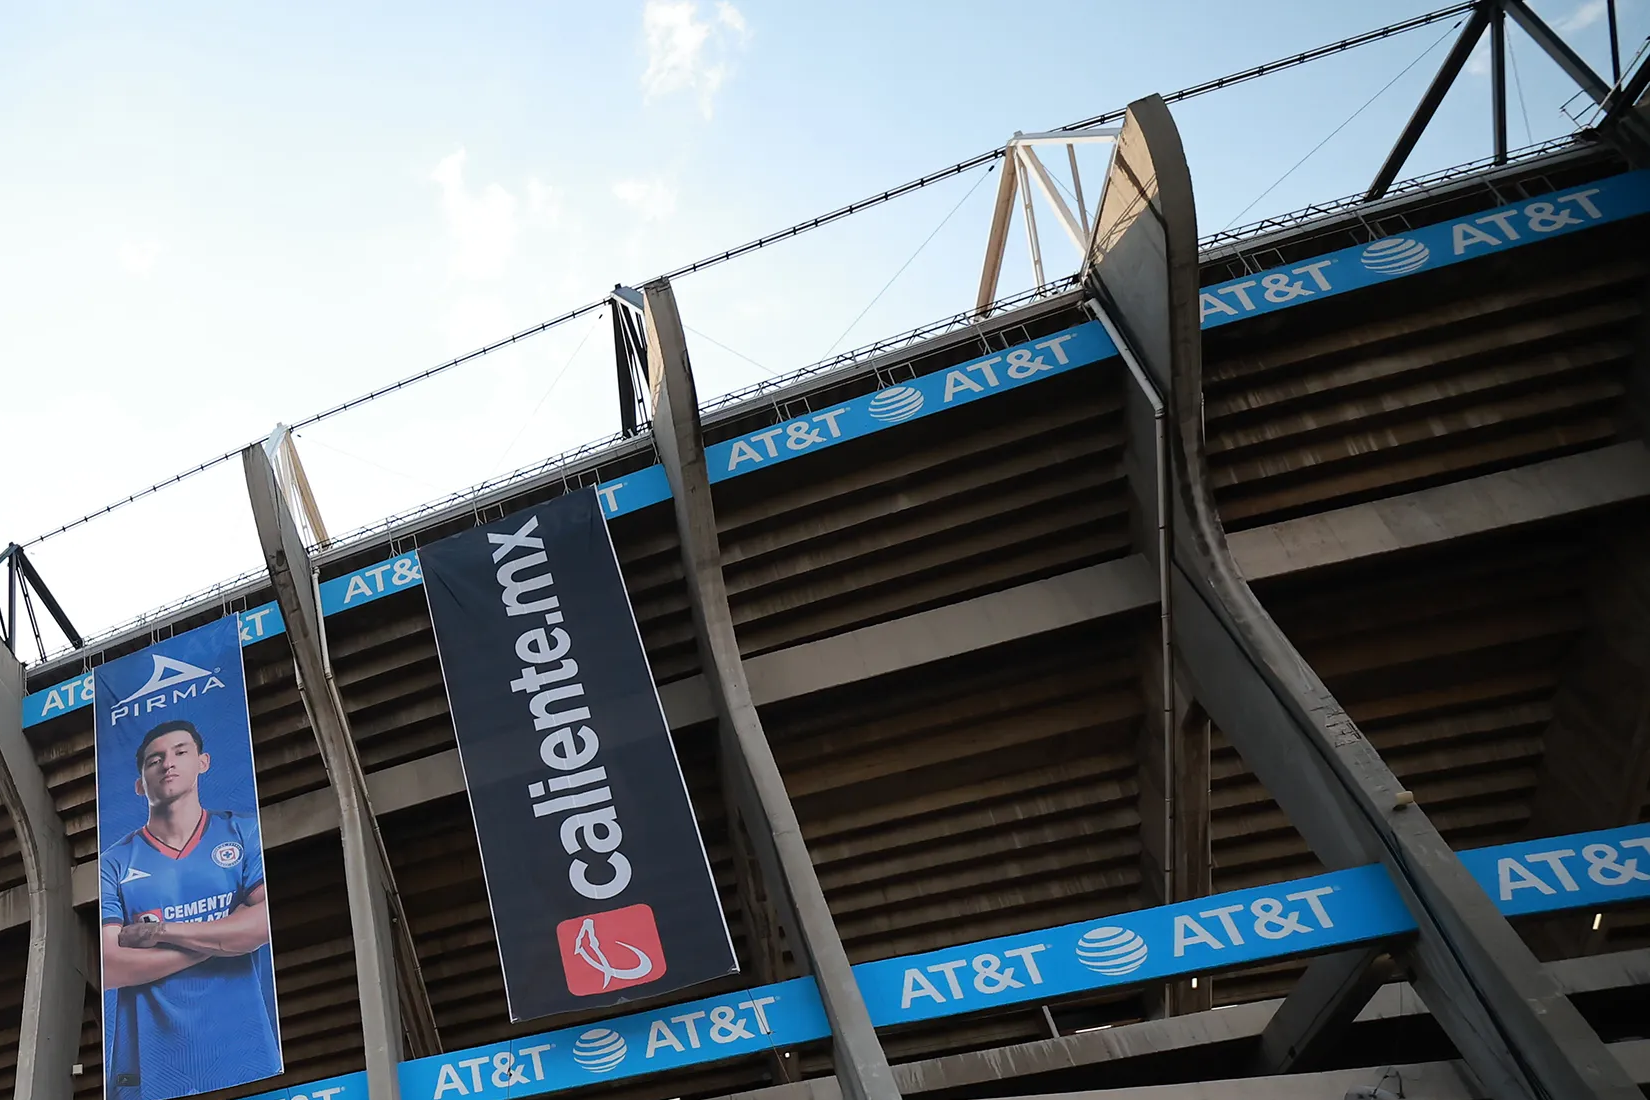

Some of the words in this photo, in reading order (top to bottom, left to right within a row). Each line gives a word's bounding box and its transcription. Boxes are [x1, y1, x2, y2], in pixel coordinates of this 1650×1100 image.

[1452, 188, 1605, 256] AT&T
[727, 407, 846, 471] AT&T
[943, 334, 1074, 403] AT&T
[343, 558, 422, 604] AT&
[41, 676, 94, 716] AT&
[111, 676, 225, 726] PIRMA
[486, 516, 632, 899] caliente.mx
[164, 892, 233, 920] CEMENTO
[901, 944, 1045, 1009] AT&T
[1173, 886, 1334, 957] AT&T
[433, 1044, 550, 1100] AT&T
[646, 996, 775, 1058] AT&T
